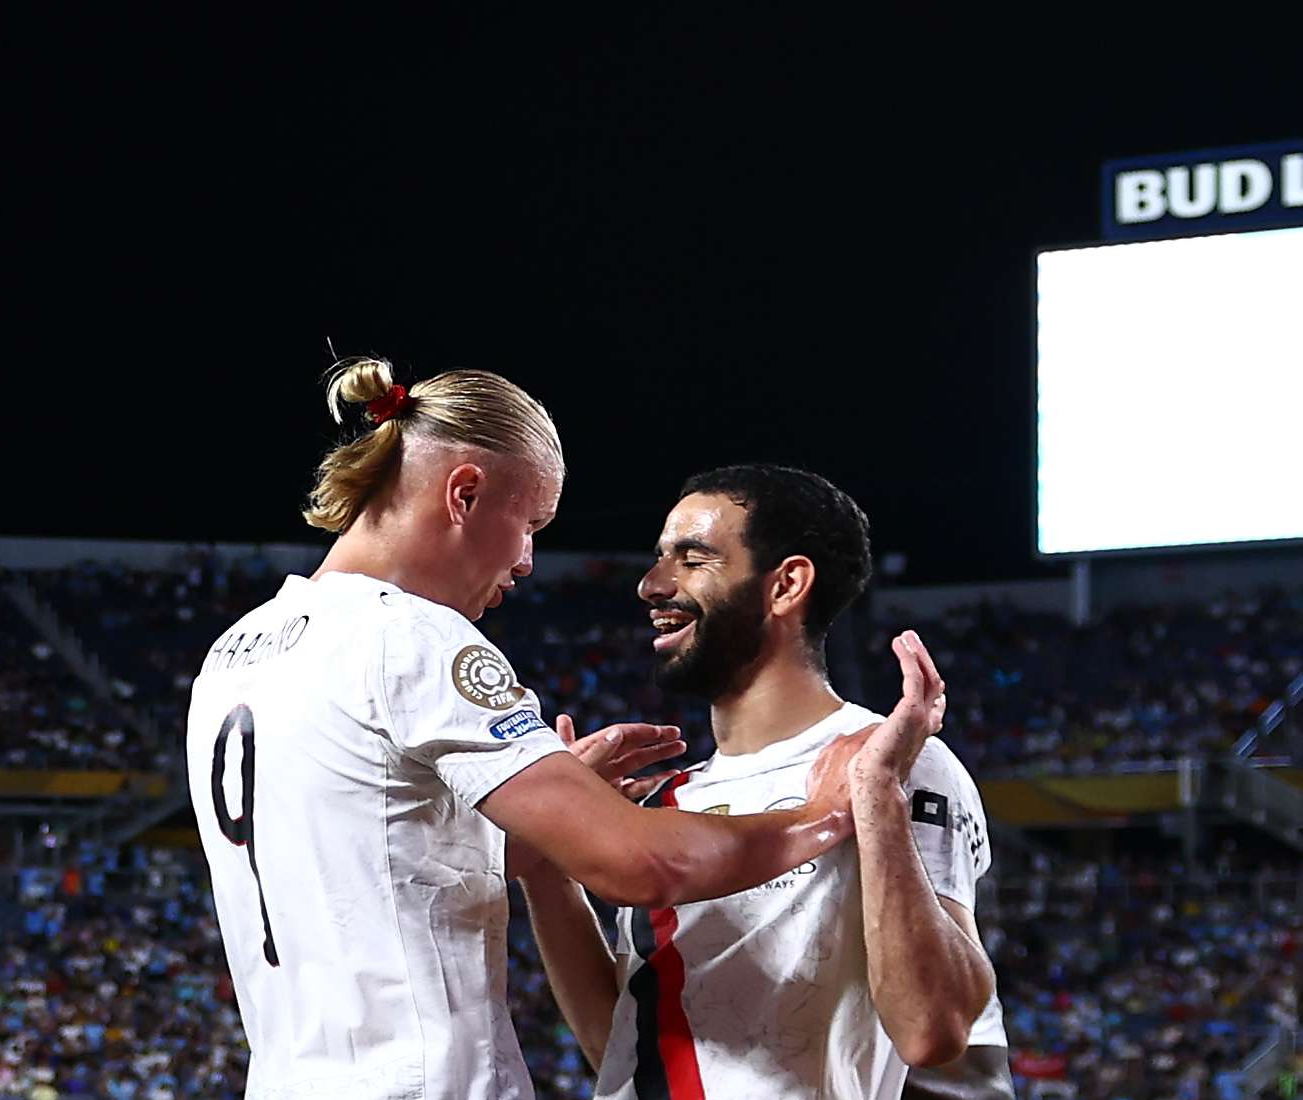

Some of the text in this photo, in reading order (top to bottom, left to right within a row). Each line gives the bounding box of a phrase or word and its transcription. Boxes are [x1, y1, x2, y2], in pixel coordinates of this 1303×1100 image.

[1115, 158, 1274, 225] BUD
[488, 691, 515, 706] FIFA
[211, 702, 280, 968] 9
